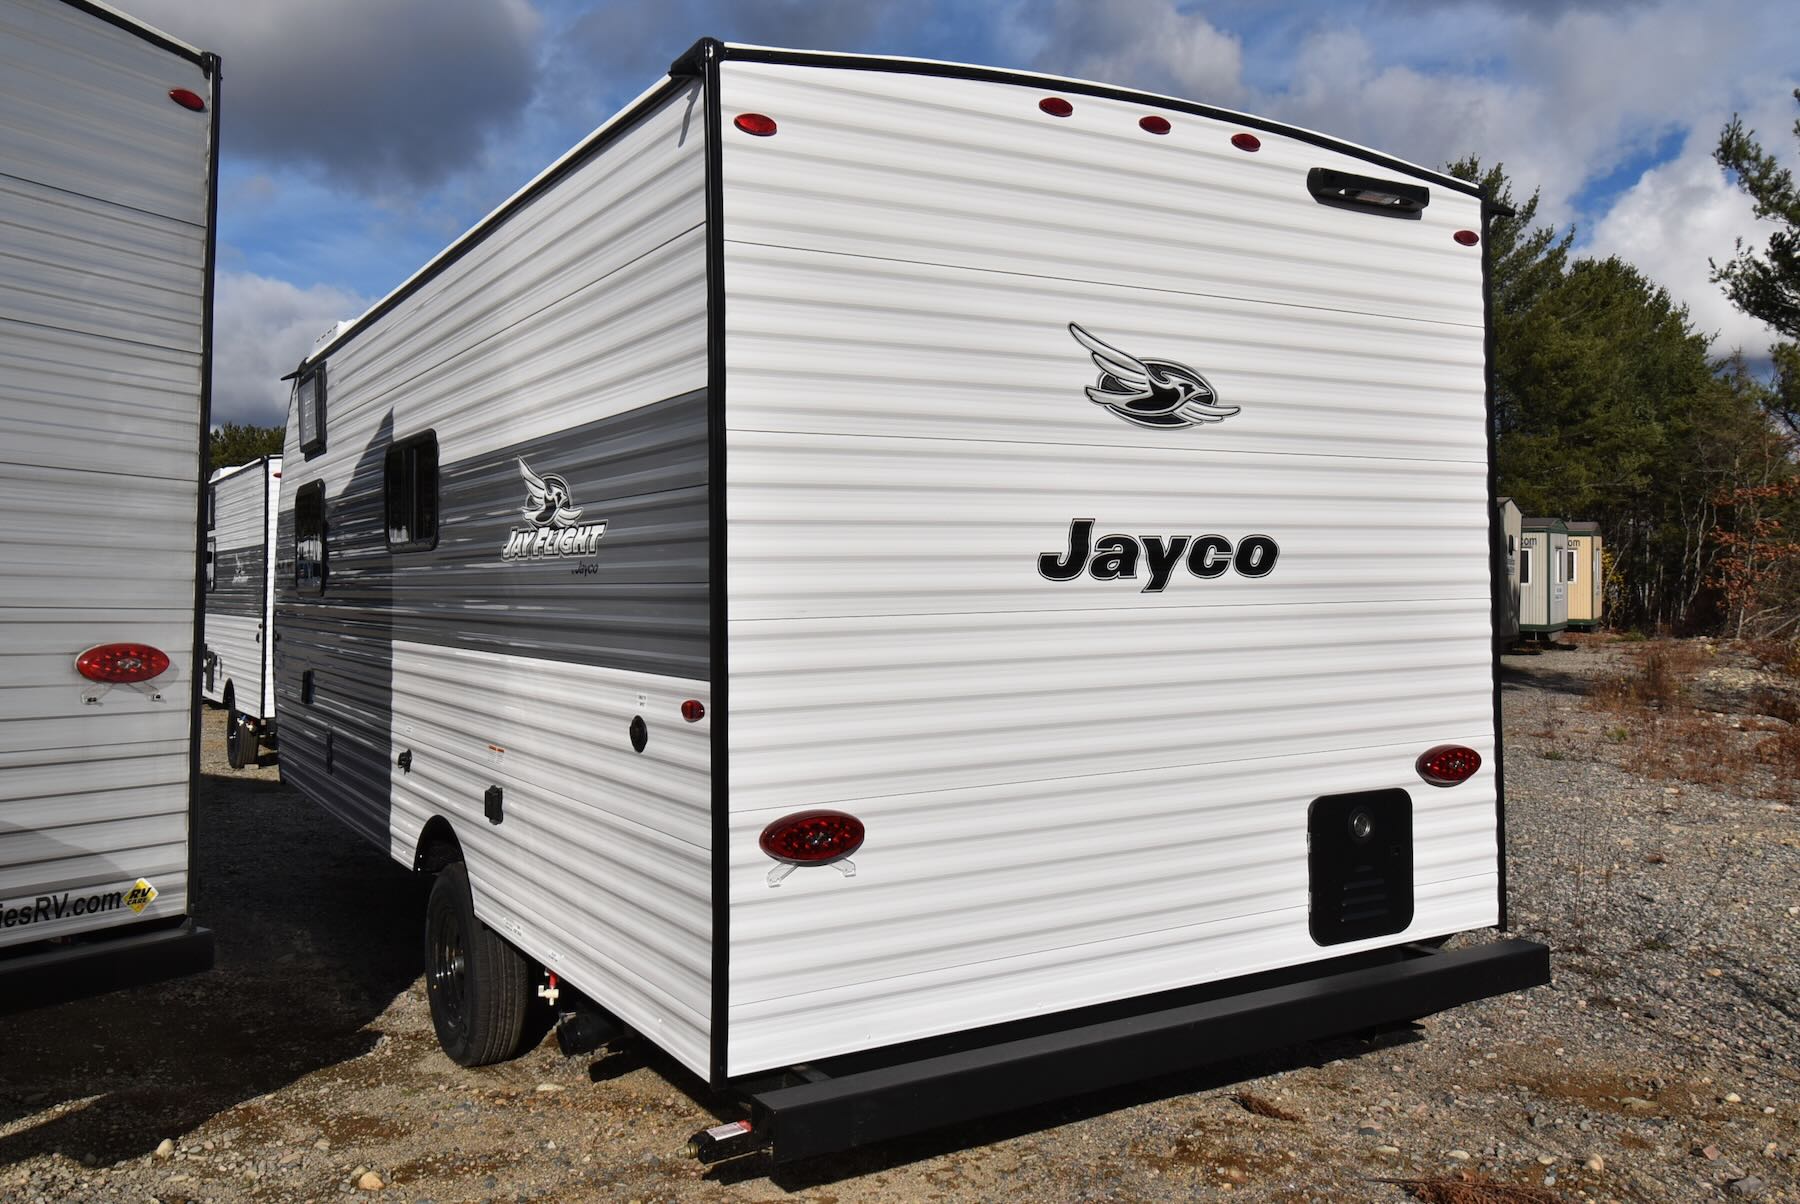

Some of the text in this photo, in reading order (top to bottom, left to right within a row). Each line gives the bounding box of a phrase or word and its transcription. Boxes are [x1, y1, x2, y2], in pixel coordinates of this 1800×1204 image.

[502, 520, 607, 559] JAY FLIGHT
[1037, 518, 1280, 593] Jayco
[129, 887, 152, 899] RV
